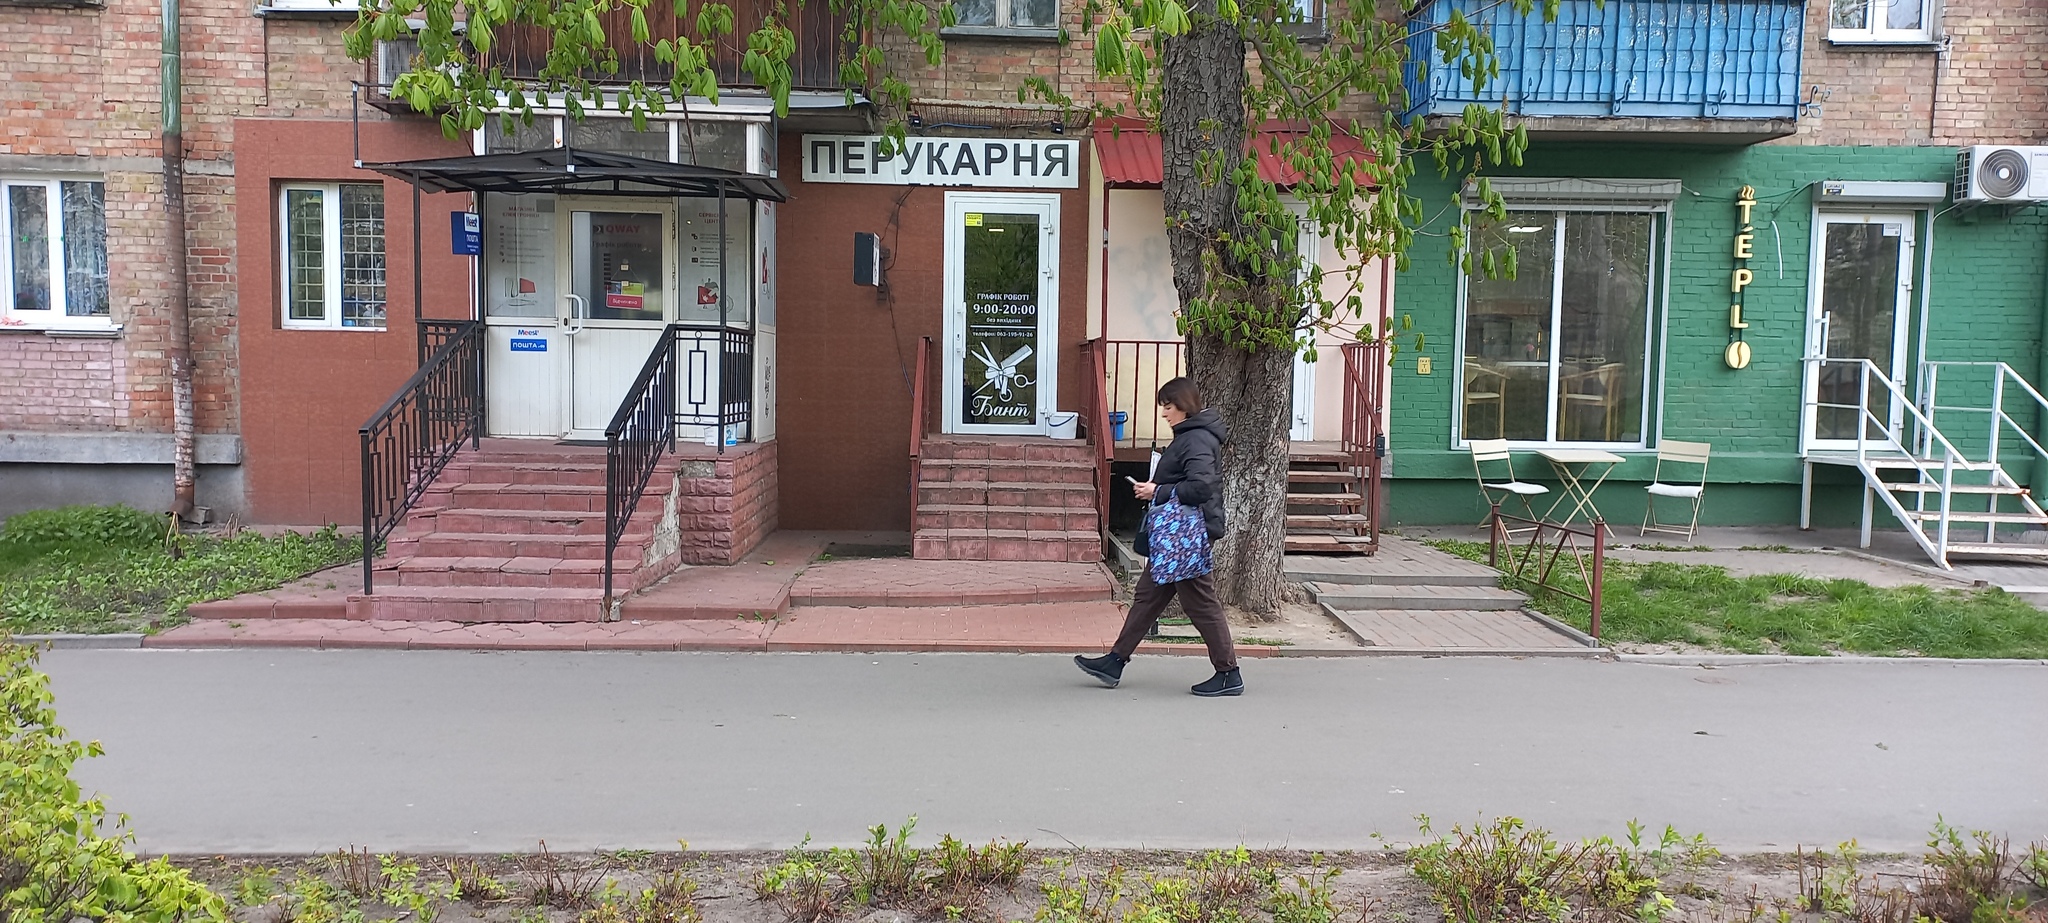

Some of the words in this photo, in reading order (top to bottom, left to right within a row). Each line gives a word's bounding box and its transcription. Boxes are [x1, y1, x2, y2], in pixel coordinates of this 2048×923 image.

[810, 140, 1070, 177] ПЕРУКАРНЯ
[973, 303, 1035, 314] 9:00-20:00
[970, 395, 1031, 417] Бант
